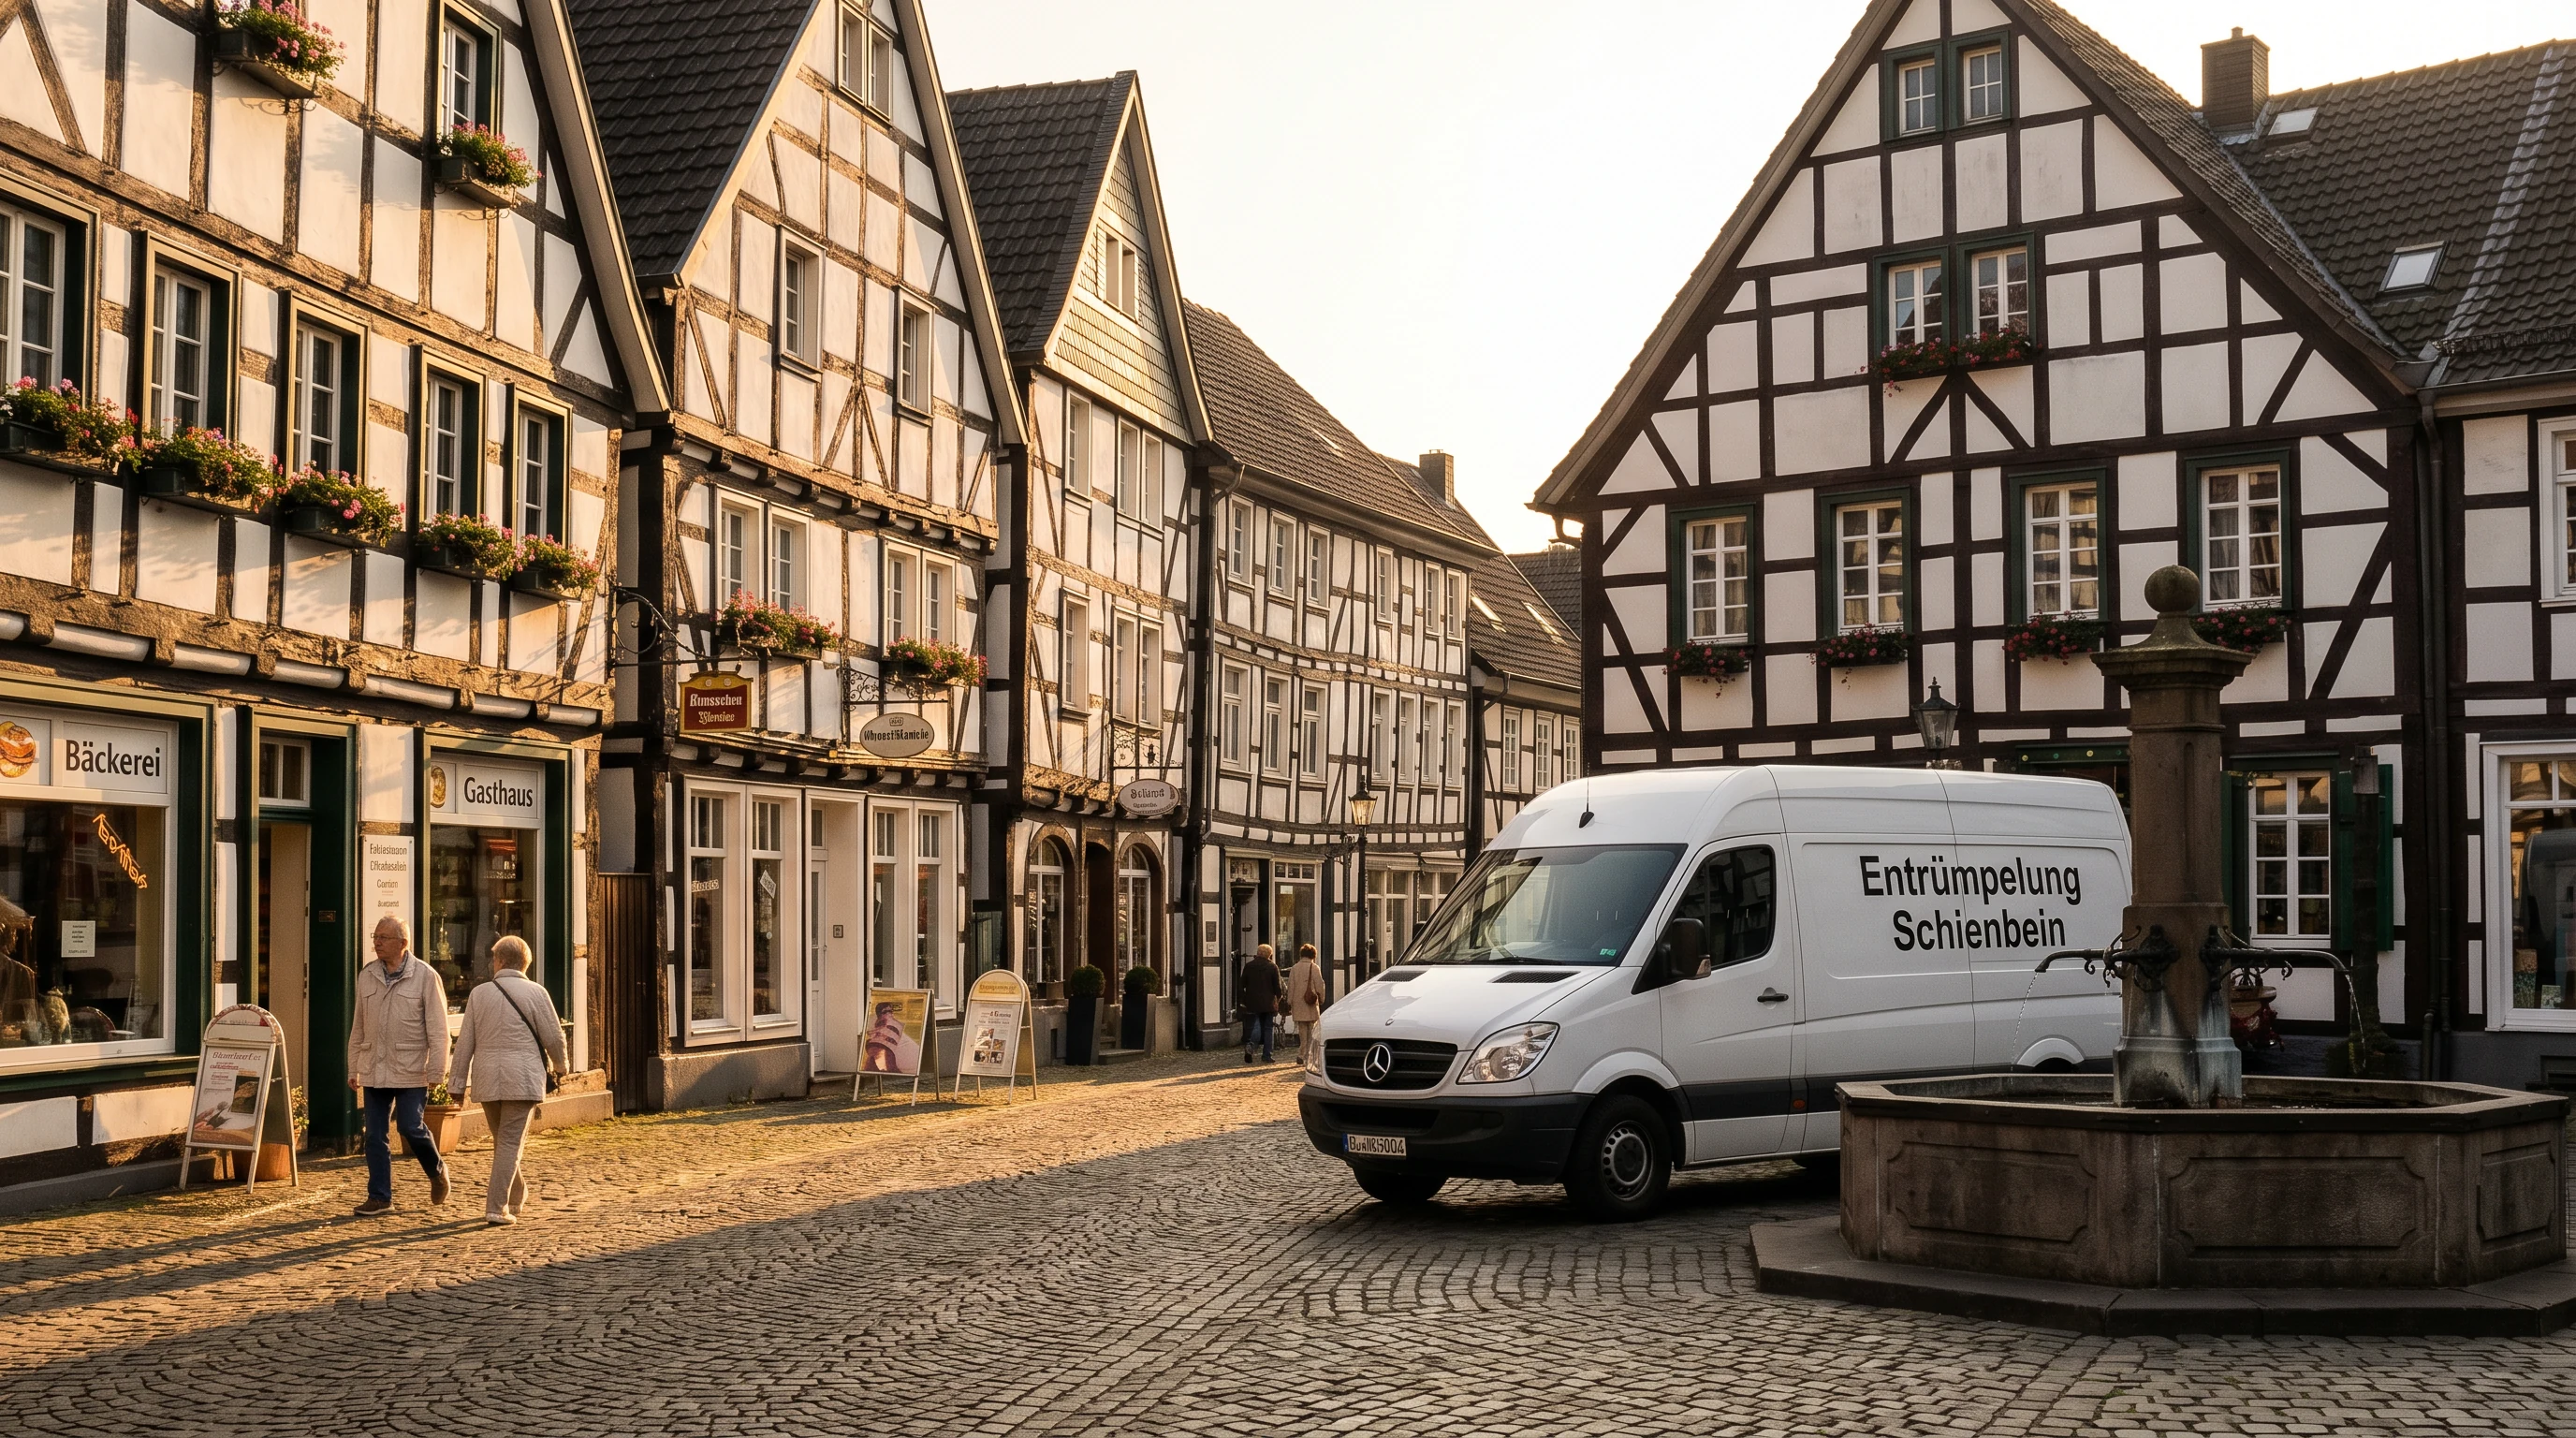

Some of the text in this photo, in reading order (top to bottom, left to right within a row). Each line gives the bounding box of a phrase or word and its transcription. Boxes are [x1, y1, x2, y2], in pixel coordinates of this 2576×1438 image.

[66, 739, 160, 777] Bäckerei
[463, 776, 534, 807] Gasthaus
[1859, 855, 2082, 905] Entrümpelung
[1893, 908, 2066, 951] Schienbein
